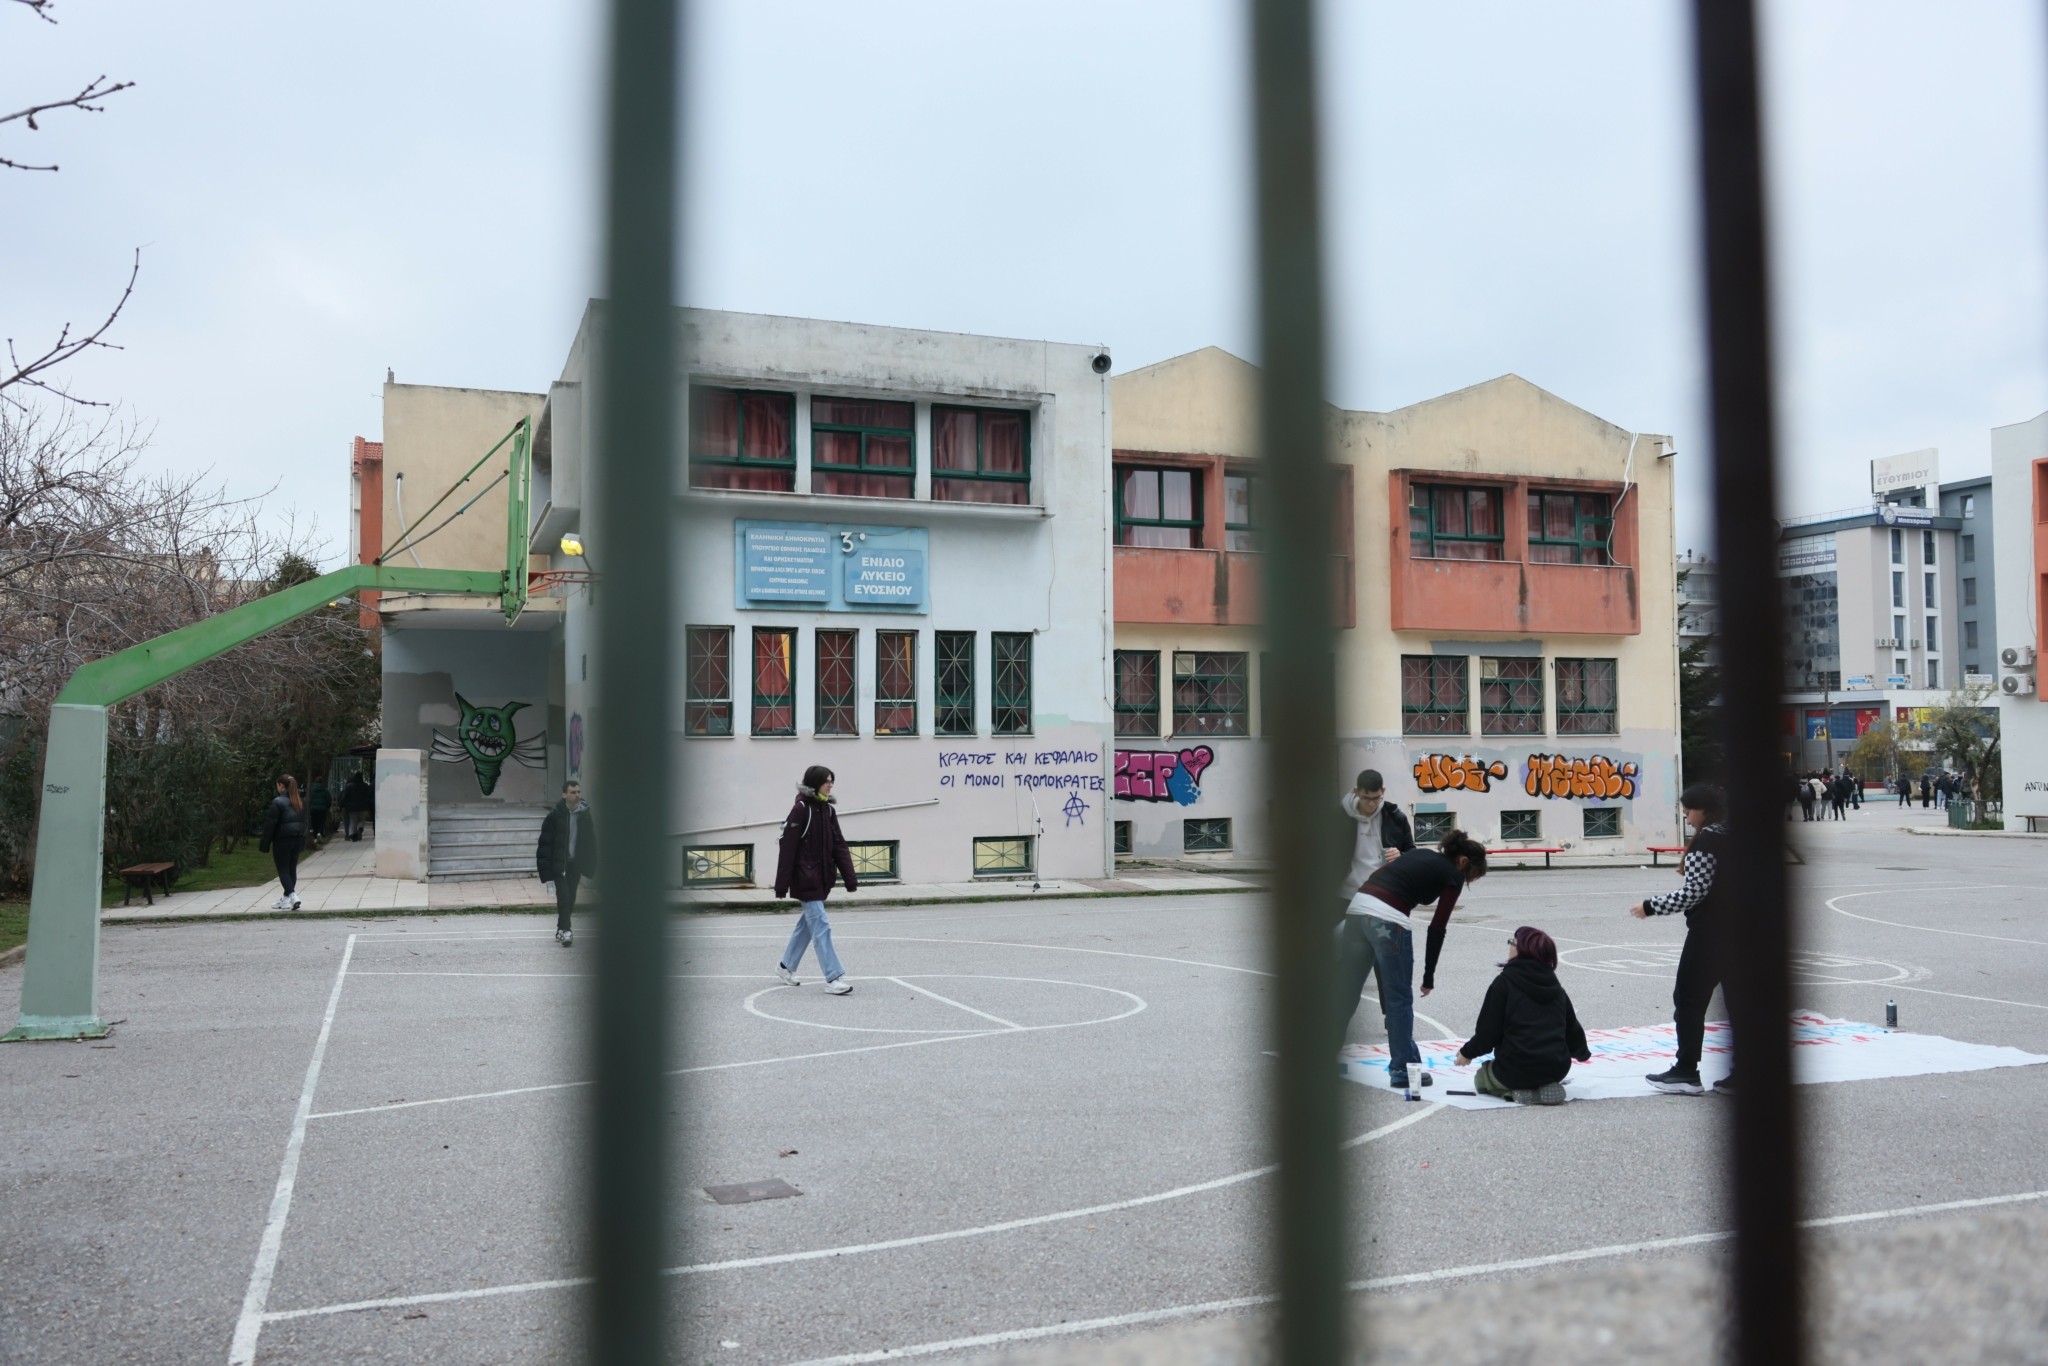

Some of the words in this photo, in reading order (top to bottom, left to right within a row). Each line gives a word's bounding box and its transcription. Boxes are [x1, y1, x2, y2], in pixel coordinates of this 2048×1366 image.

[1877, 468, 1929, 486] ΕΥΘΥΜΙΟΥ
[750, 533, 784, 541] ΕΛΛΗΝΙΚΗ
[785, 535, 825, 543] ΔΗΜΟΚΡΑΤΙΑ
[861, 556, 905, 568] ΕΝΙΑΙΟ
[860, 571, 906, 582] ΛΥΚΕΙΟ
[854, 584, 913, 596] ΕΥΟΣΜΟΥ
[939, 751, 996, 769] ΚΡΑΤΟΣ
[1005, 751, 1028, 766] ΚΑΙ
[1034, 751, 1098, 766] ΚΕΦΑΛΑΙΟ
[940, 774, 954, 788] ΟΙ
[964, 773, 1004, 788] ΜΟΝΟΙ
